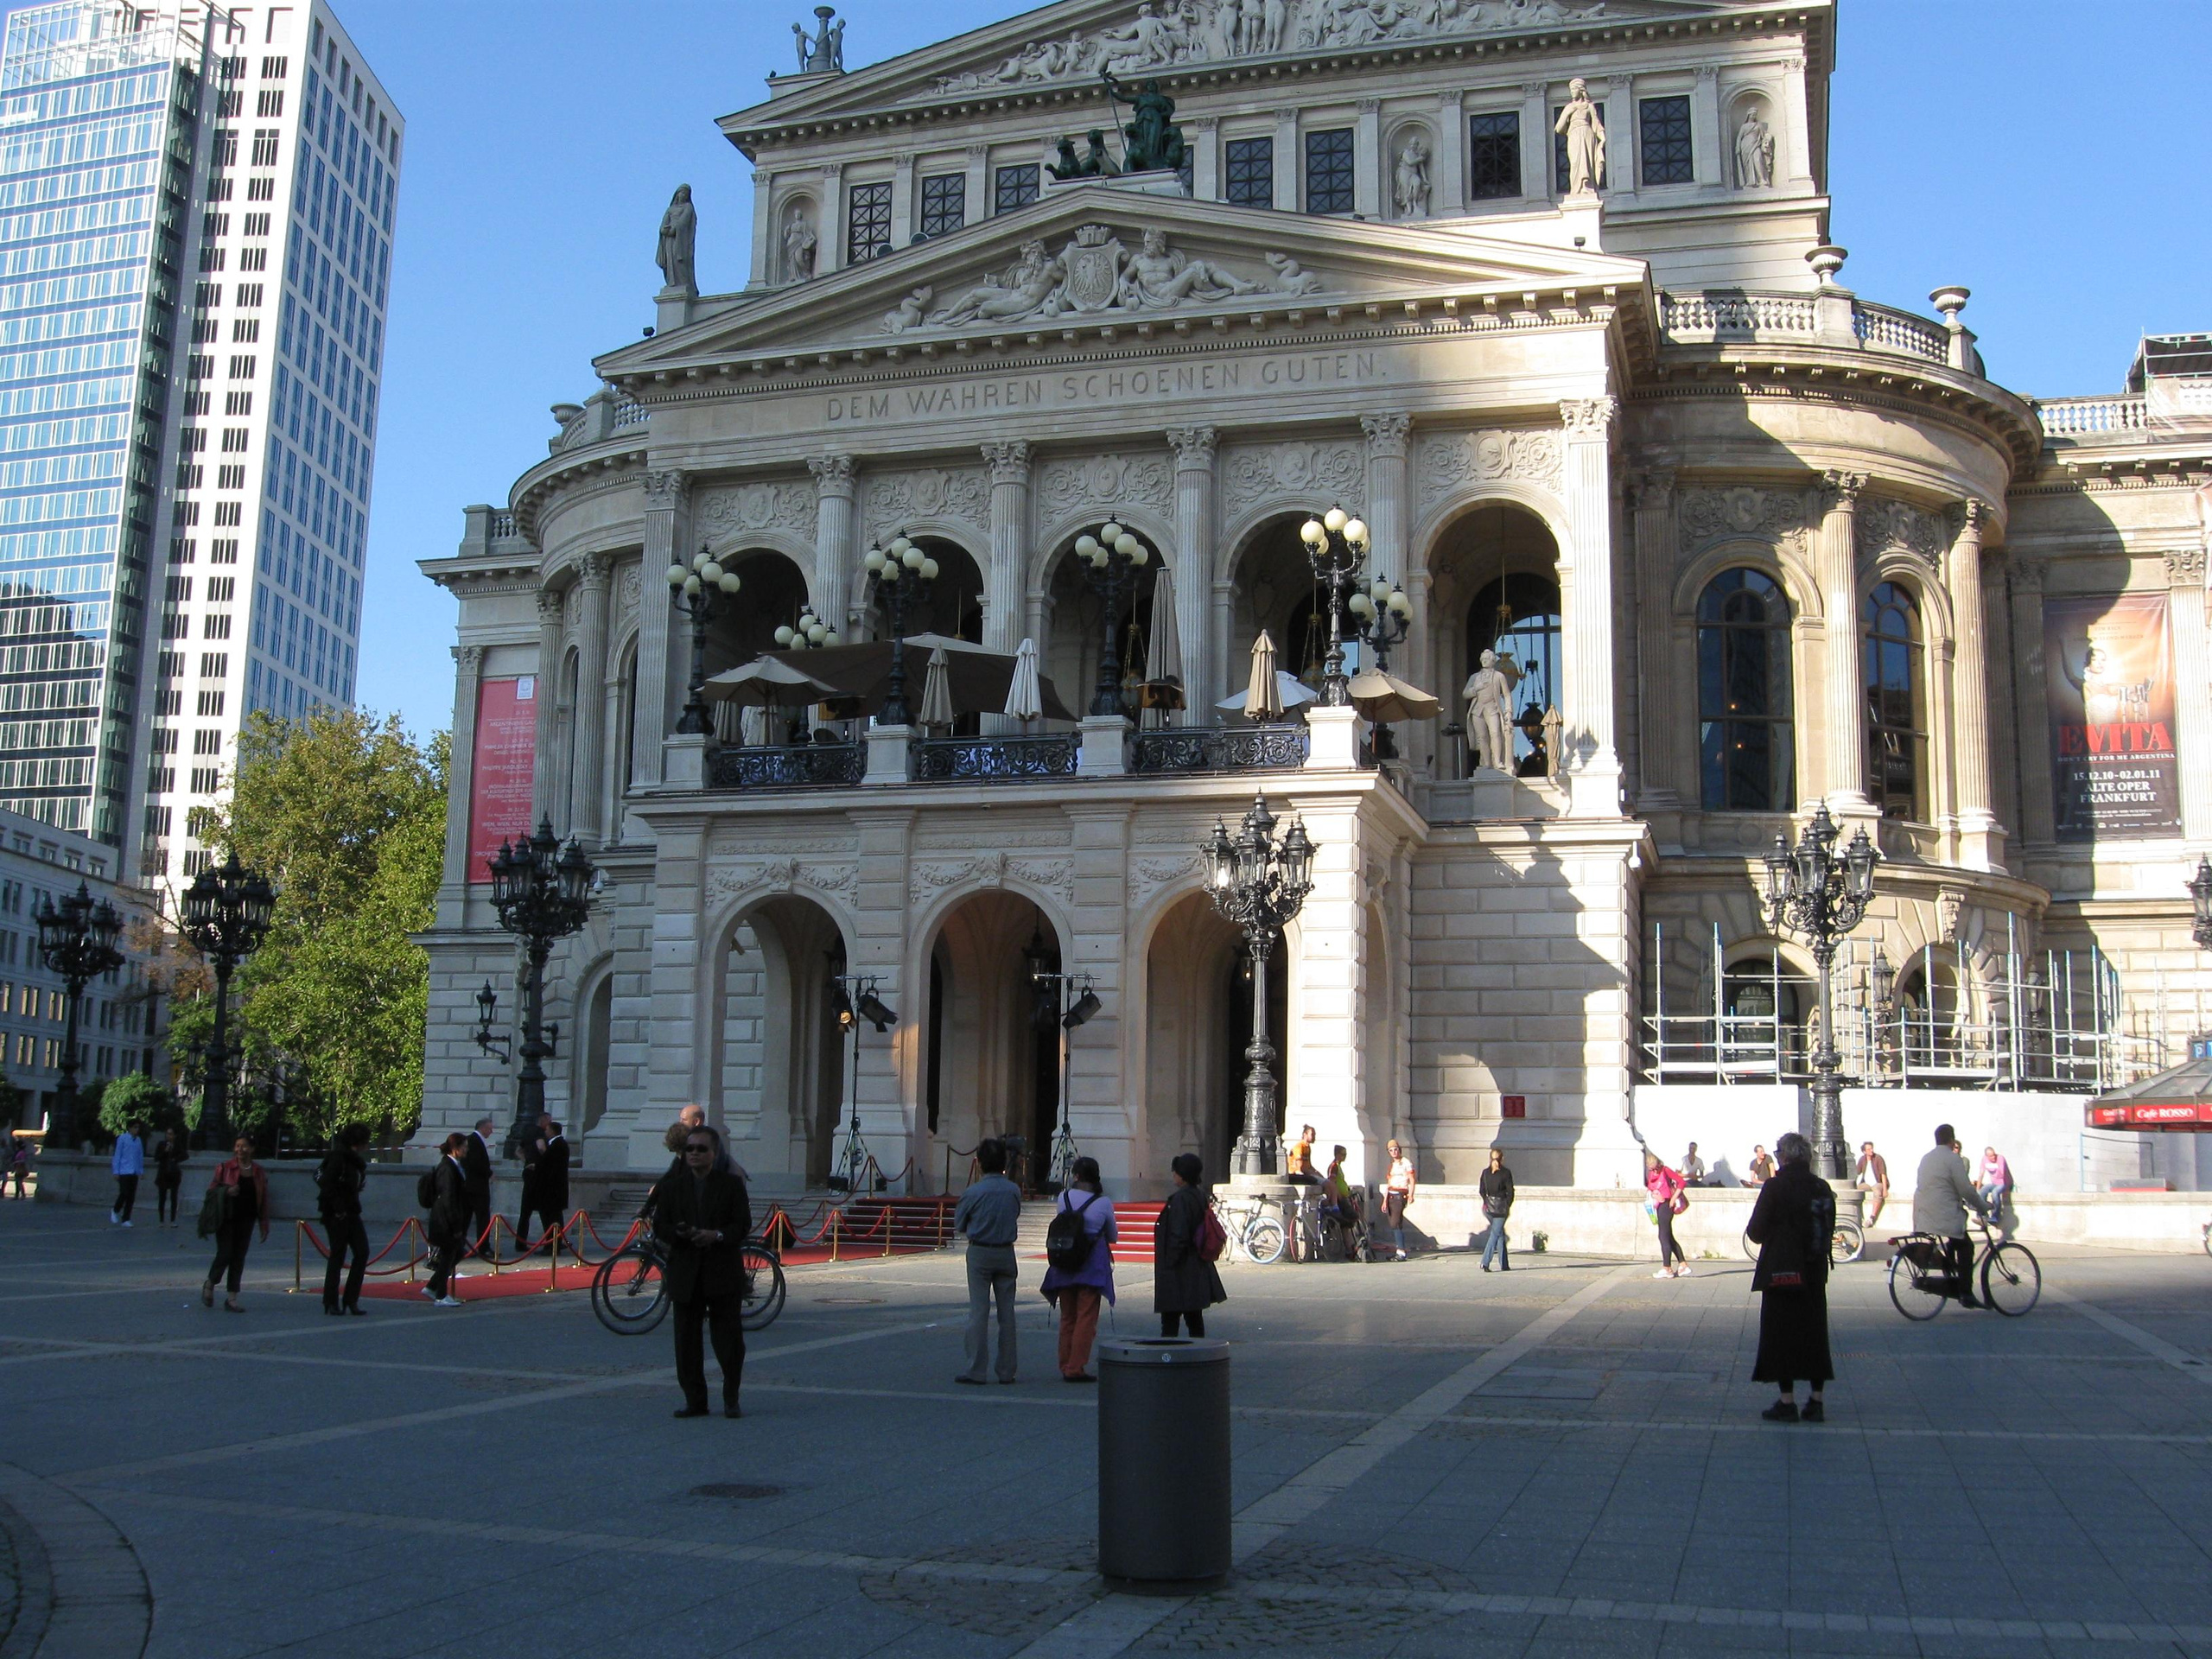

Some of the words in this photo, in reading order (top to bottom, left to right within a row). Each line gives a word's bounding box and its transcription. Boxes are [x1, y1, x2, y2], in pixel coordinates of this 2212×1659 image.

[827, 394, 889, 421] DEM
[907, 380, 1042, 415] WAHREN
[1063, 364, 1239, 399] SCHOENEN
[1262, 353, 1386, 384] GUTEN.
[2059, 722, 2175, 753] EVITA
[2085, 782, 2115, 792] ALTE
[2117, 781, 2151, 791] OPER
[2080, 791, 2157, 803] FRANKFURT
[2158, 1108, 2194, 1119] ROSSO
